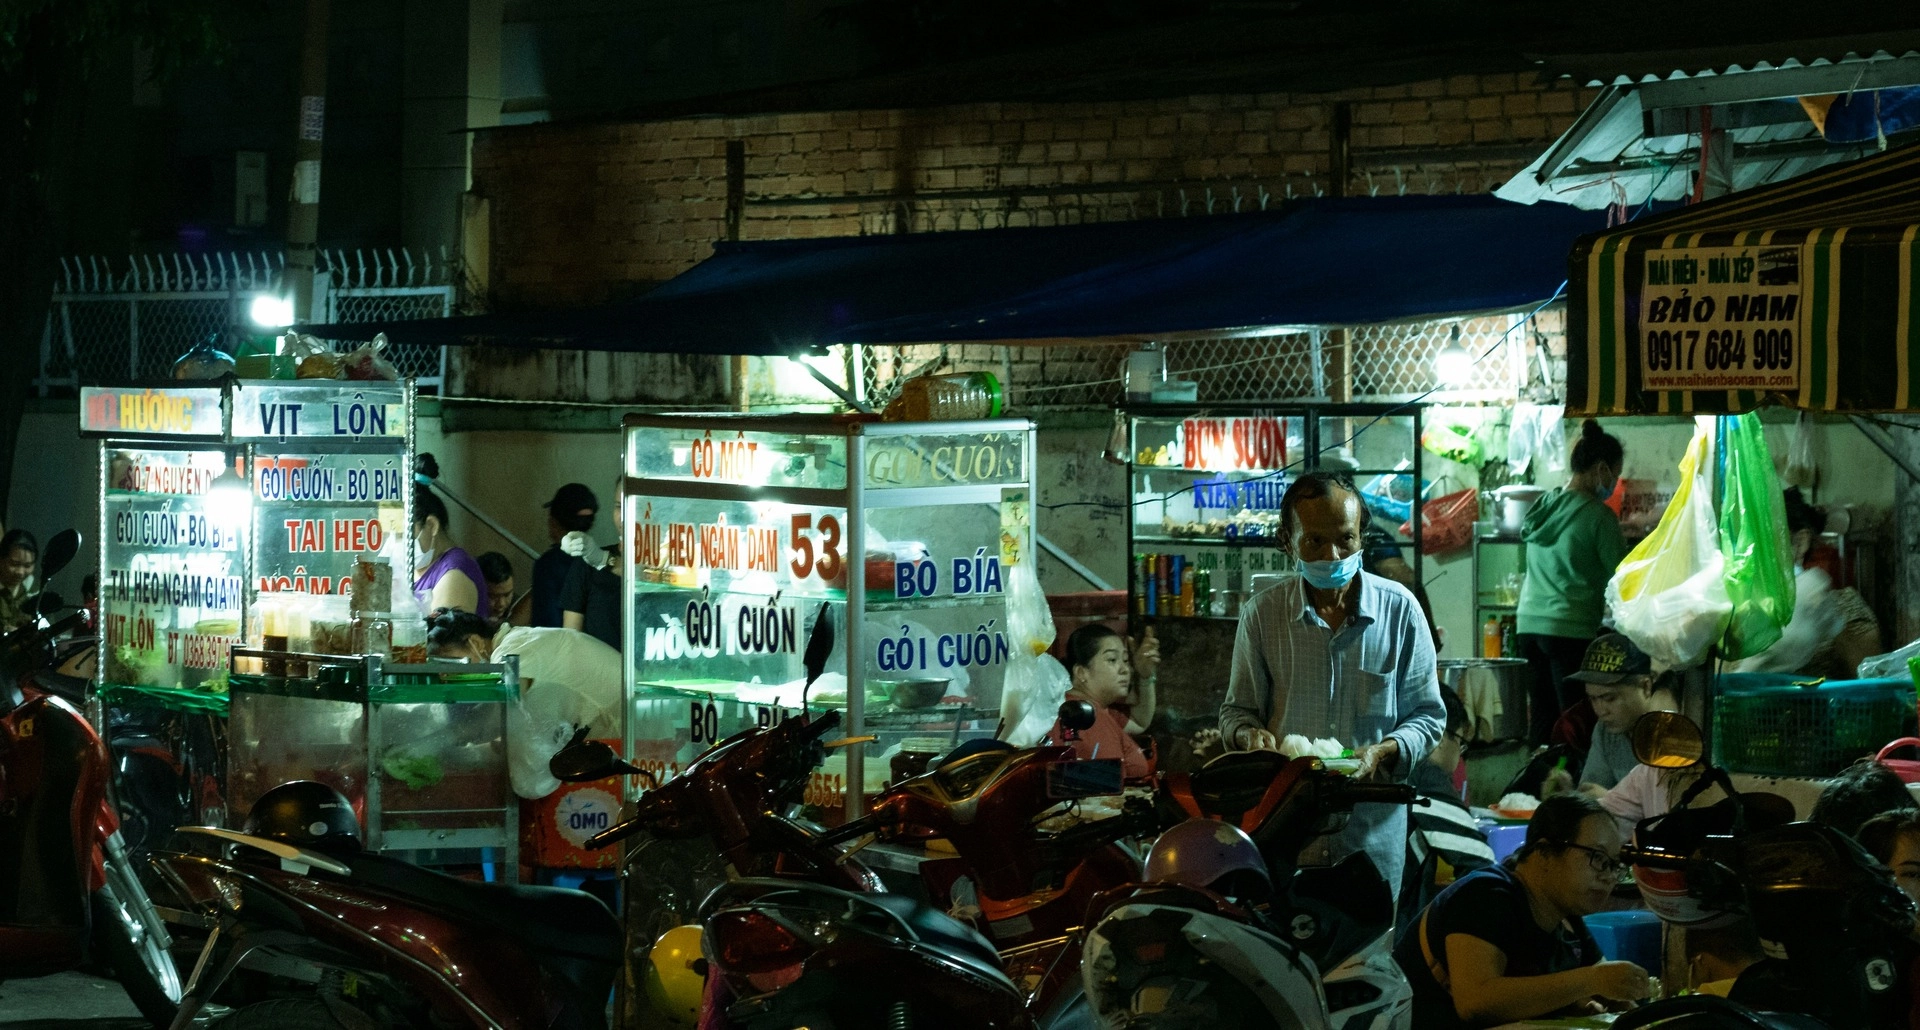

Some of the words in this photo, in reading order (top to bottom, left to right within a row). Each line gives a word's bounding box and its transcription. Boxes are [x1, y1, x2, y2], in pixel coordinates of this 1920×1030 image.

[1733, 248, 1755, 283] XẾP
[1648, 288, 1715, 322] BẢO
[1725, 294, 1798, 322] NAM
[1648, 330, 1699, 371] 0917
[1705, 330, 1746, 370] 684
[1753, 328, 1792, 370] 909
[1649, 373, 1793, 387] www.maihienbaonam.com
[260, 403, 303, 443] VỊT
[333, 392, 386, 442] LỘN
[126, 453, 142, 492] SỐ
[155, 453, 201, 494] NGUYỄN
[691, 429, 713, 478] CÔ
[261, 455, 286, 499] GỎI
[291, 455, 333, 500] CUỐN
[348, 460, 368, 501] BÒ
[374, 460, 399, 500] BÍA
[117, 498, 139, 544] GỎI
[142, 499, 178, 546] CUỐN
[189, 505, 207, 547] BÒ
[286, 520, 325, 552] TAI
[335, 519, 382, 552] HEO
[634, 502, 660, 567] ĐẦU
[669, 523, 695, 569] HEO
[700, 513, 739, 570] NGÂM
[790, 512, 841, 580] 53
[111, 570, 130, 601] TAI
[134, 571, 160, 604] HEO
[163, 563, 202, 607] NGÂM
[896, 549, 937, 598] BÒ
[953, 548, 1003, 594] BÍA
[130, 609, 154, 656] LỘN
[687, 584, 721, 649] GỎI
[739, 590, 796, 654] CUỐN
[878, 624, 926, 671] GỎI
[937, 619, 1009, 668] CUỐN
[691, 691, 718, 745] BÒ
[570, 812, 608, 830] OMO
